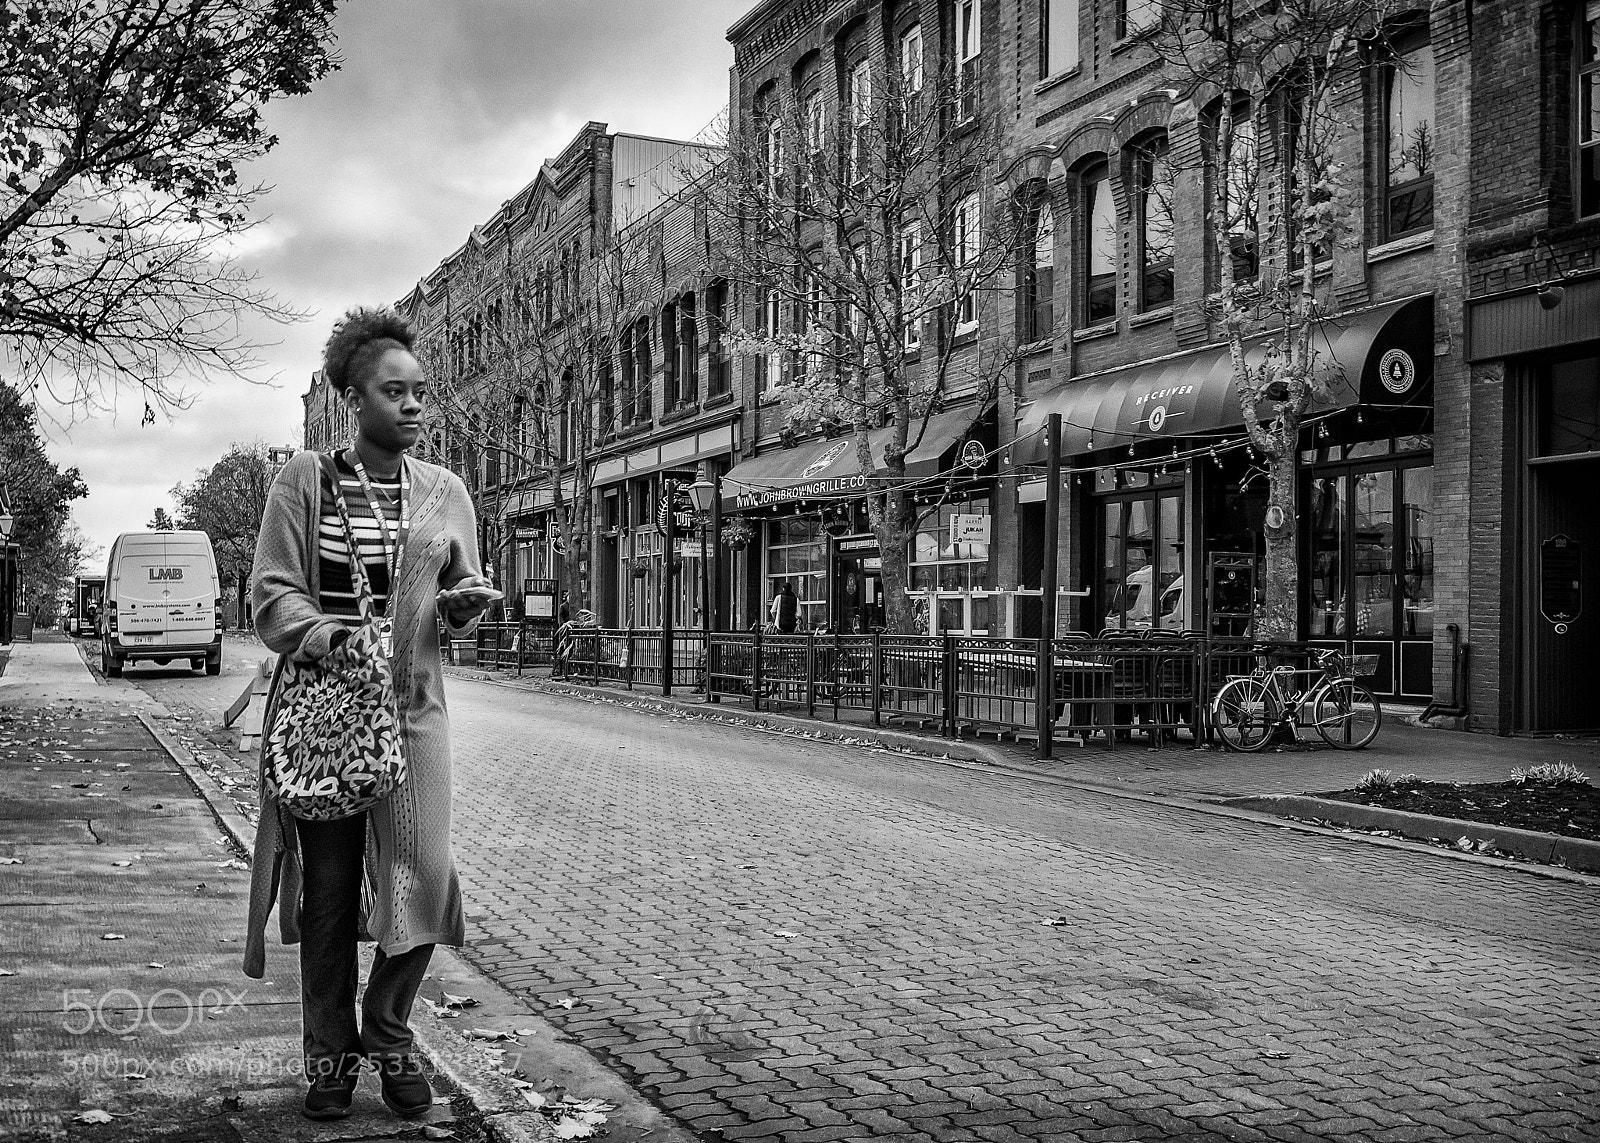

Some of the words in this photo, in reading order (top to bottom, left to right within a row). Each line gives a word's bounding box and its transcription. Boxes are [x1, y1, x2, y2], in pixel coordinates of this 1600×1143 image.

[1136, 385, 1193, 405] RECEIVER
[736, 475, 864, 508] WWW.JOHNBROWNGRILLE.CO
[149, 568, 184, 581] LMB
